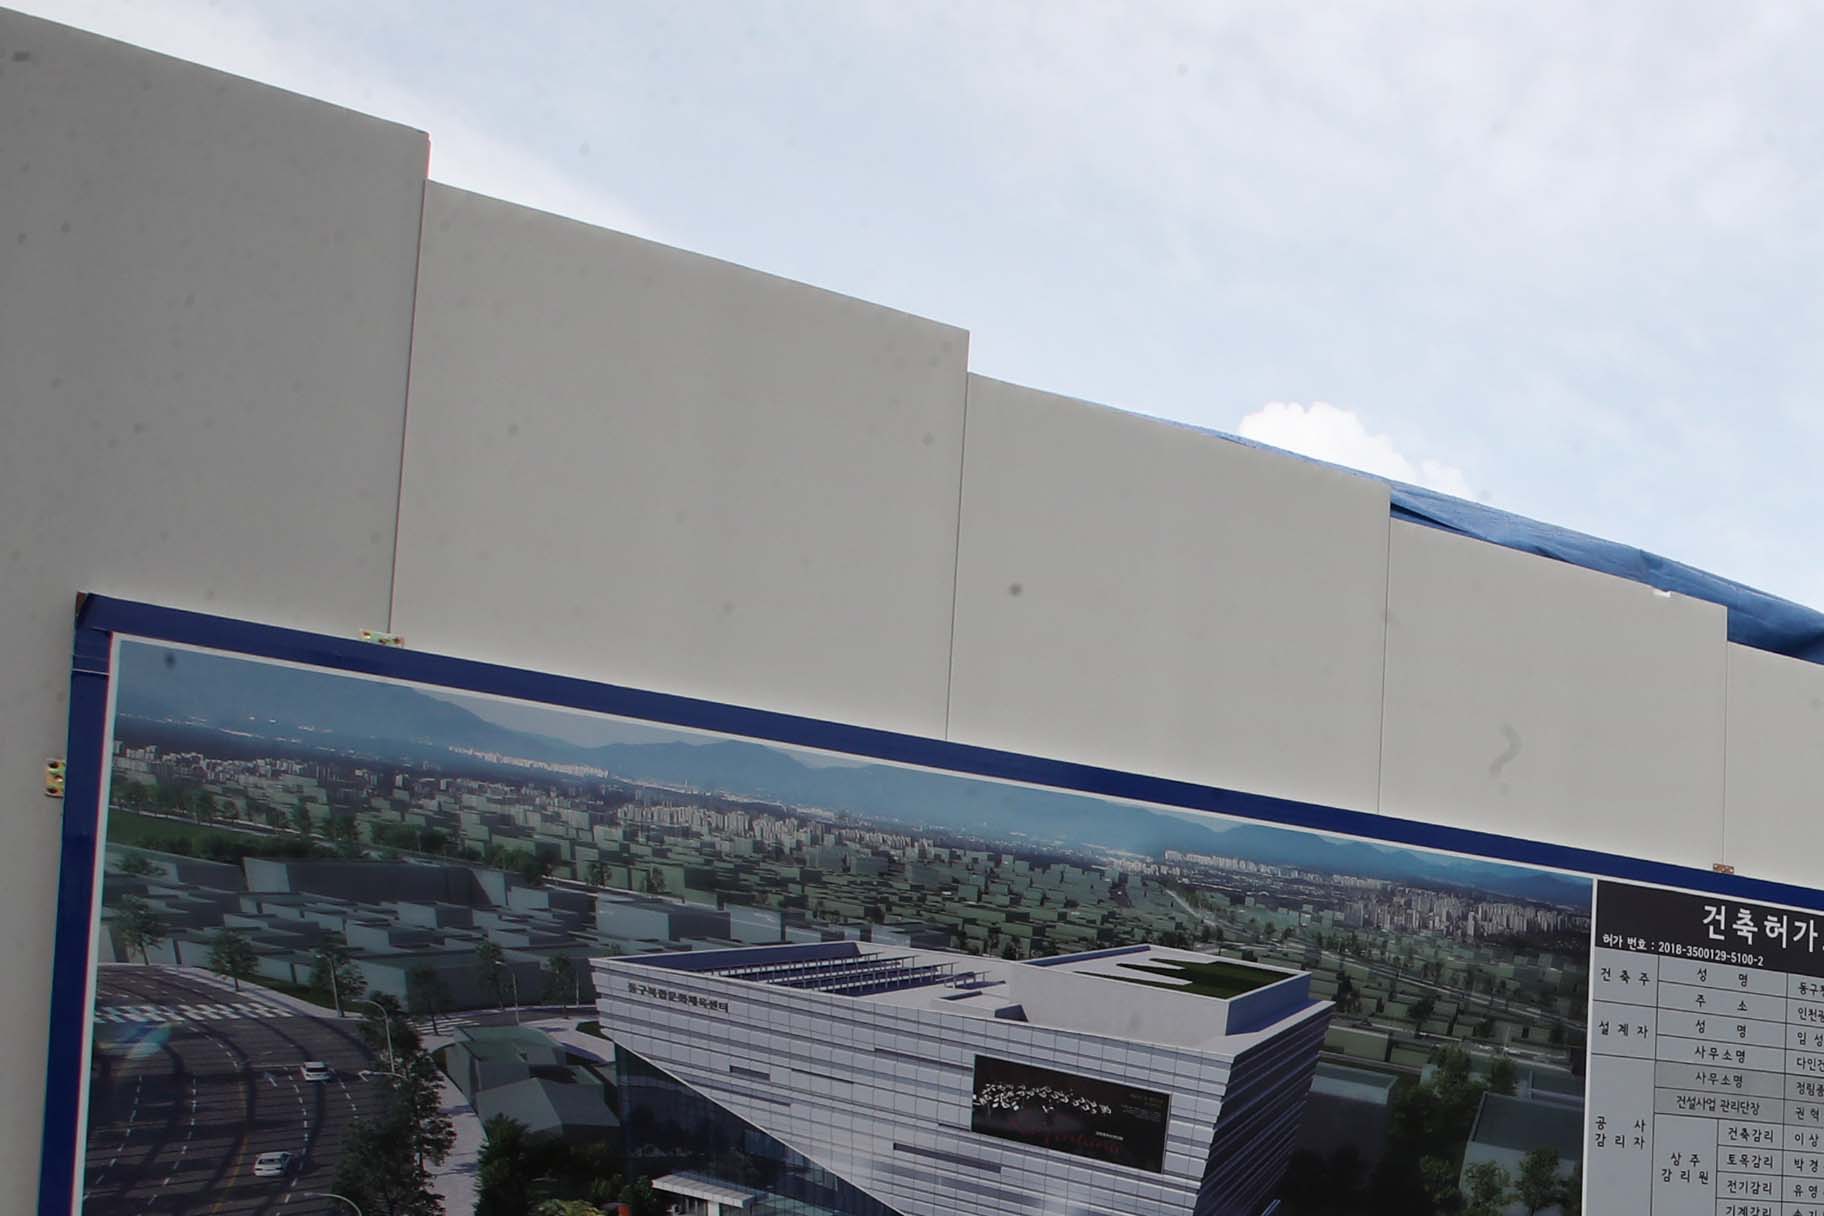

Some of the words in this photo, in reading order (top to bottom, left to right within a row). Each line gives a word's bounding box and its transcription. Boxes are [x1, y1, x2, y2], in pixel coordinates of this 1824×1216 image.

[1603, 934, 1622, 948] 허가
[1627, 938, 1647, 950] 번호
[1659, 942, 1764, 966] 2018-3500129-5100-2
[1677, 1095, 1716, 1112] 건설사업
[1720, 1099, 1760, 1115] 관리단장
[1728, 1128, 1773, 1143] 건축감리
[1727, 1154, 1773, 1168] 토목감리
[1727, 1180, 1772, 1195] 전기감리
